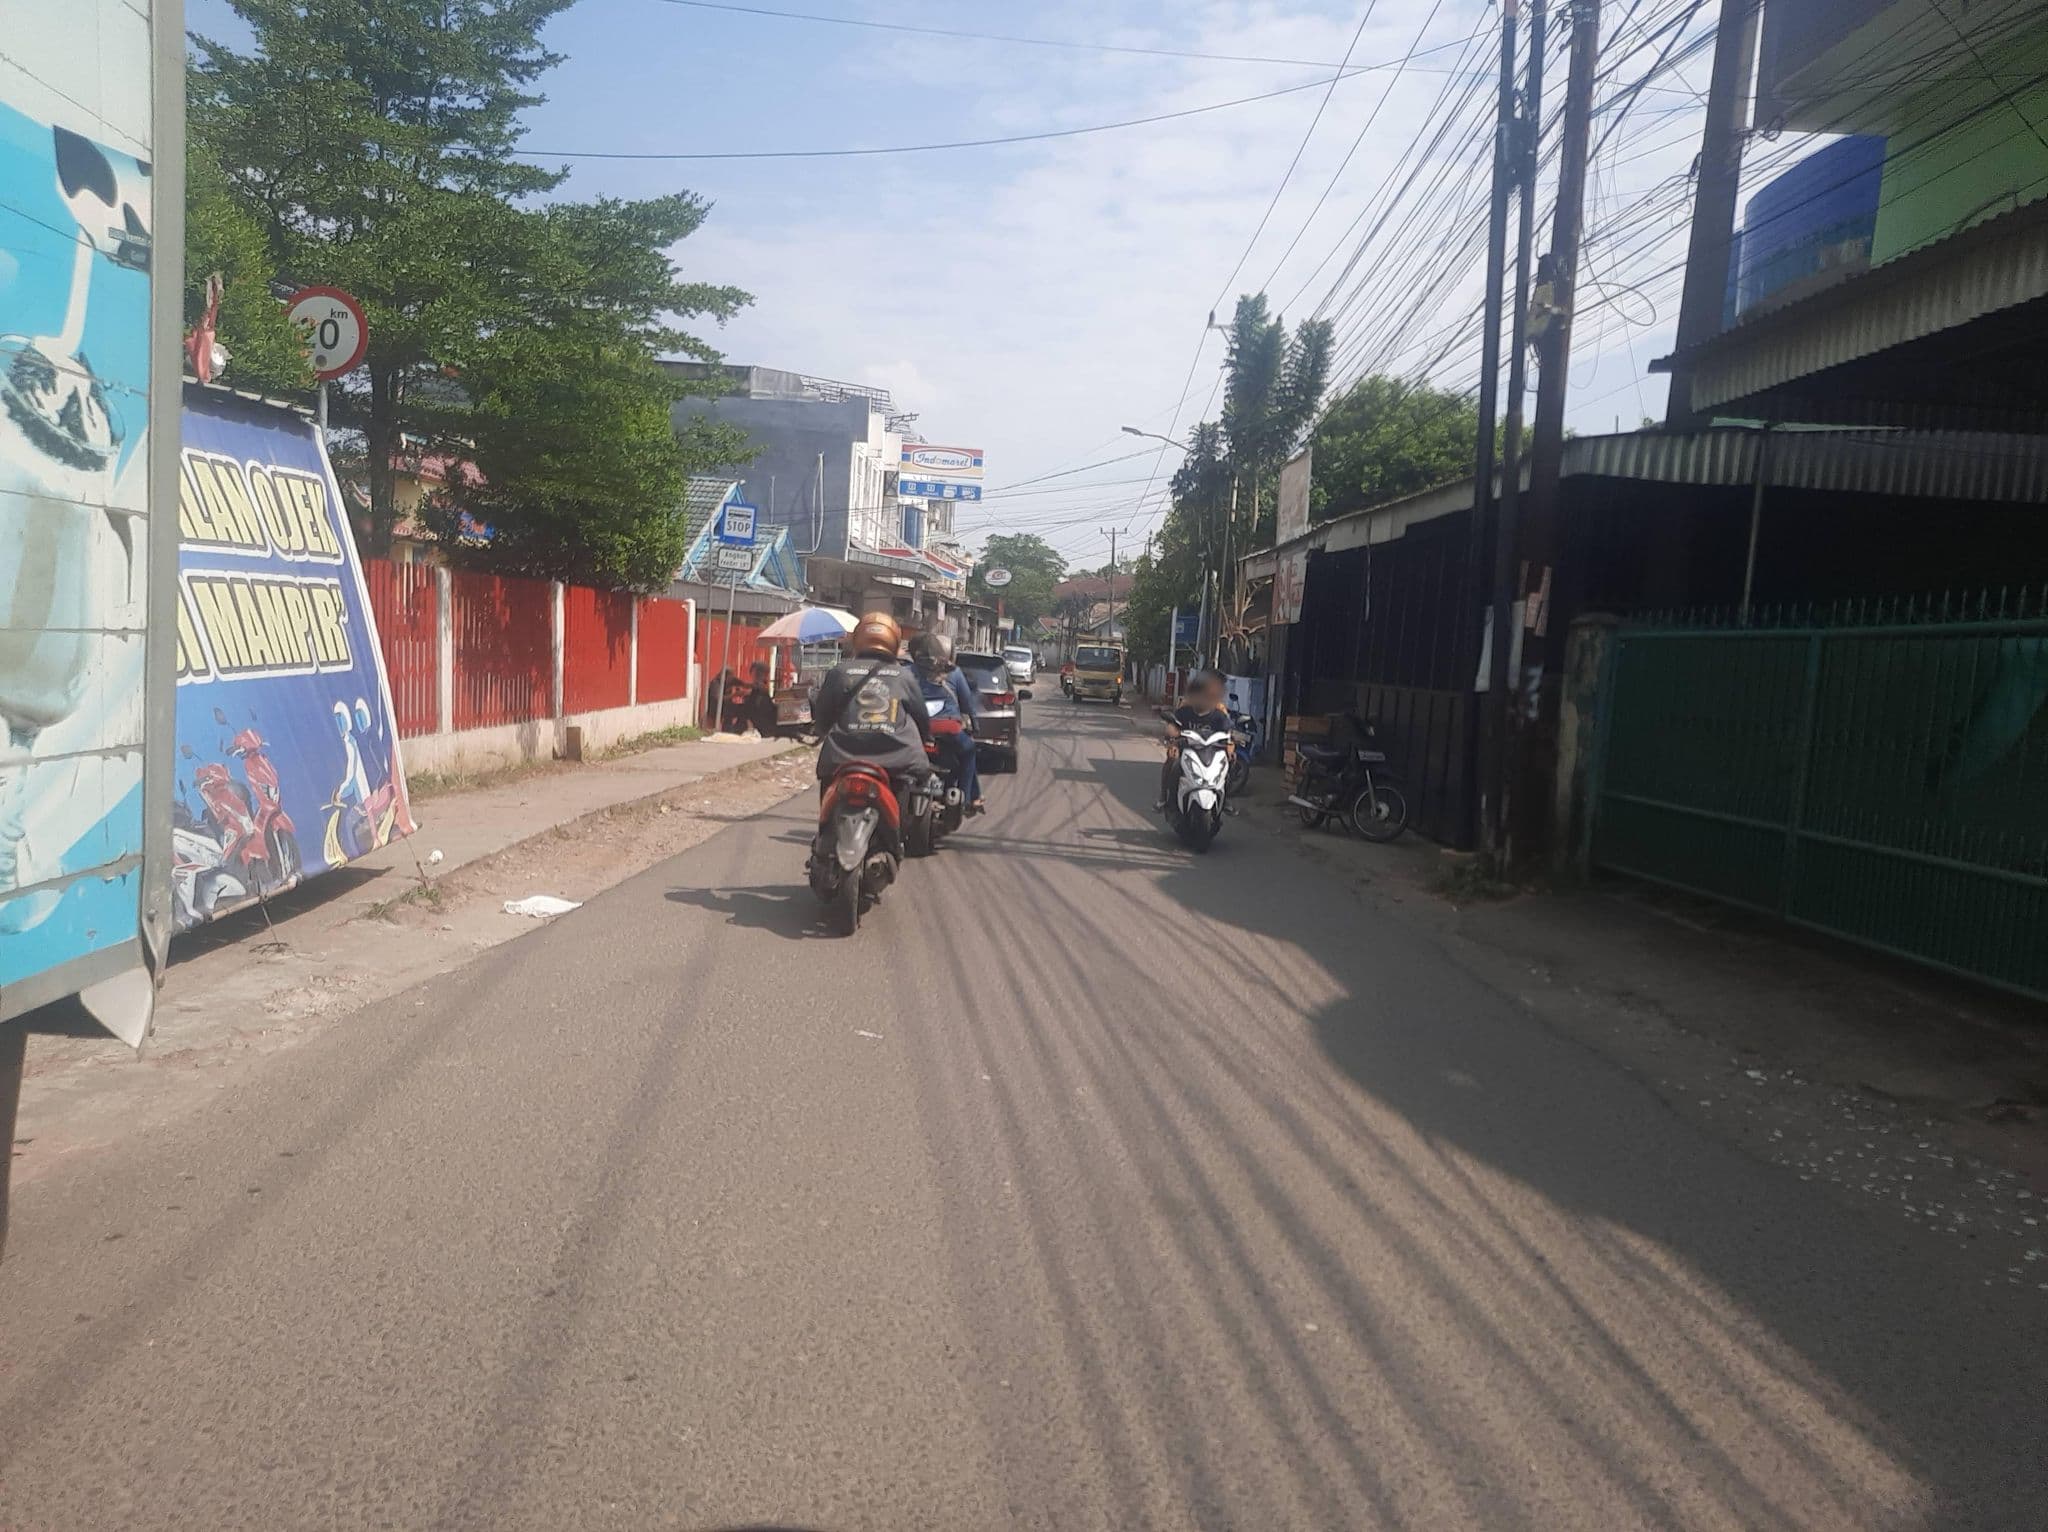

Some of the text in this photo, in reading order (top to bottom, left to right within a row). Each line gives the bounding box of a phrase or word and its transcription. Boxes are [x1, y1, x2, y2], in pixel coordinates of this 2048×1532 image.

[330, 308, 348, 319] km
[915, 453, 969, 467] Indomaret
[179, 455, 340, 557] LAN OJEK
[727, 520, 751, 533] STOP
